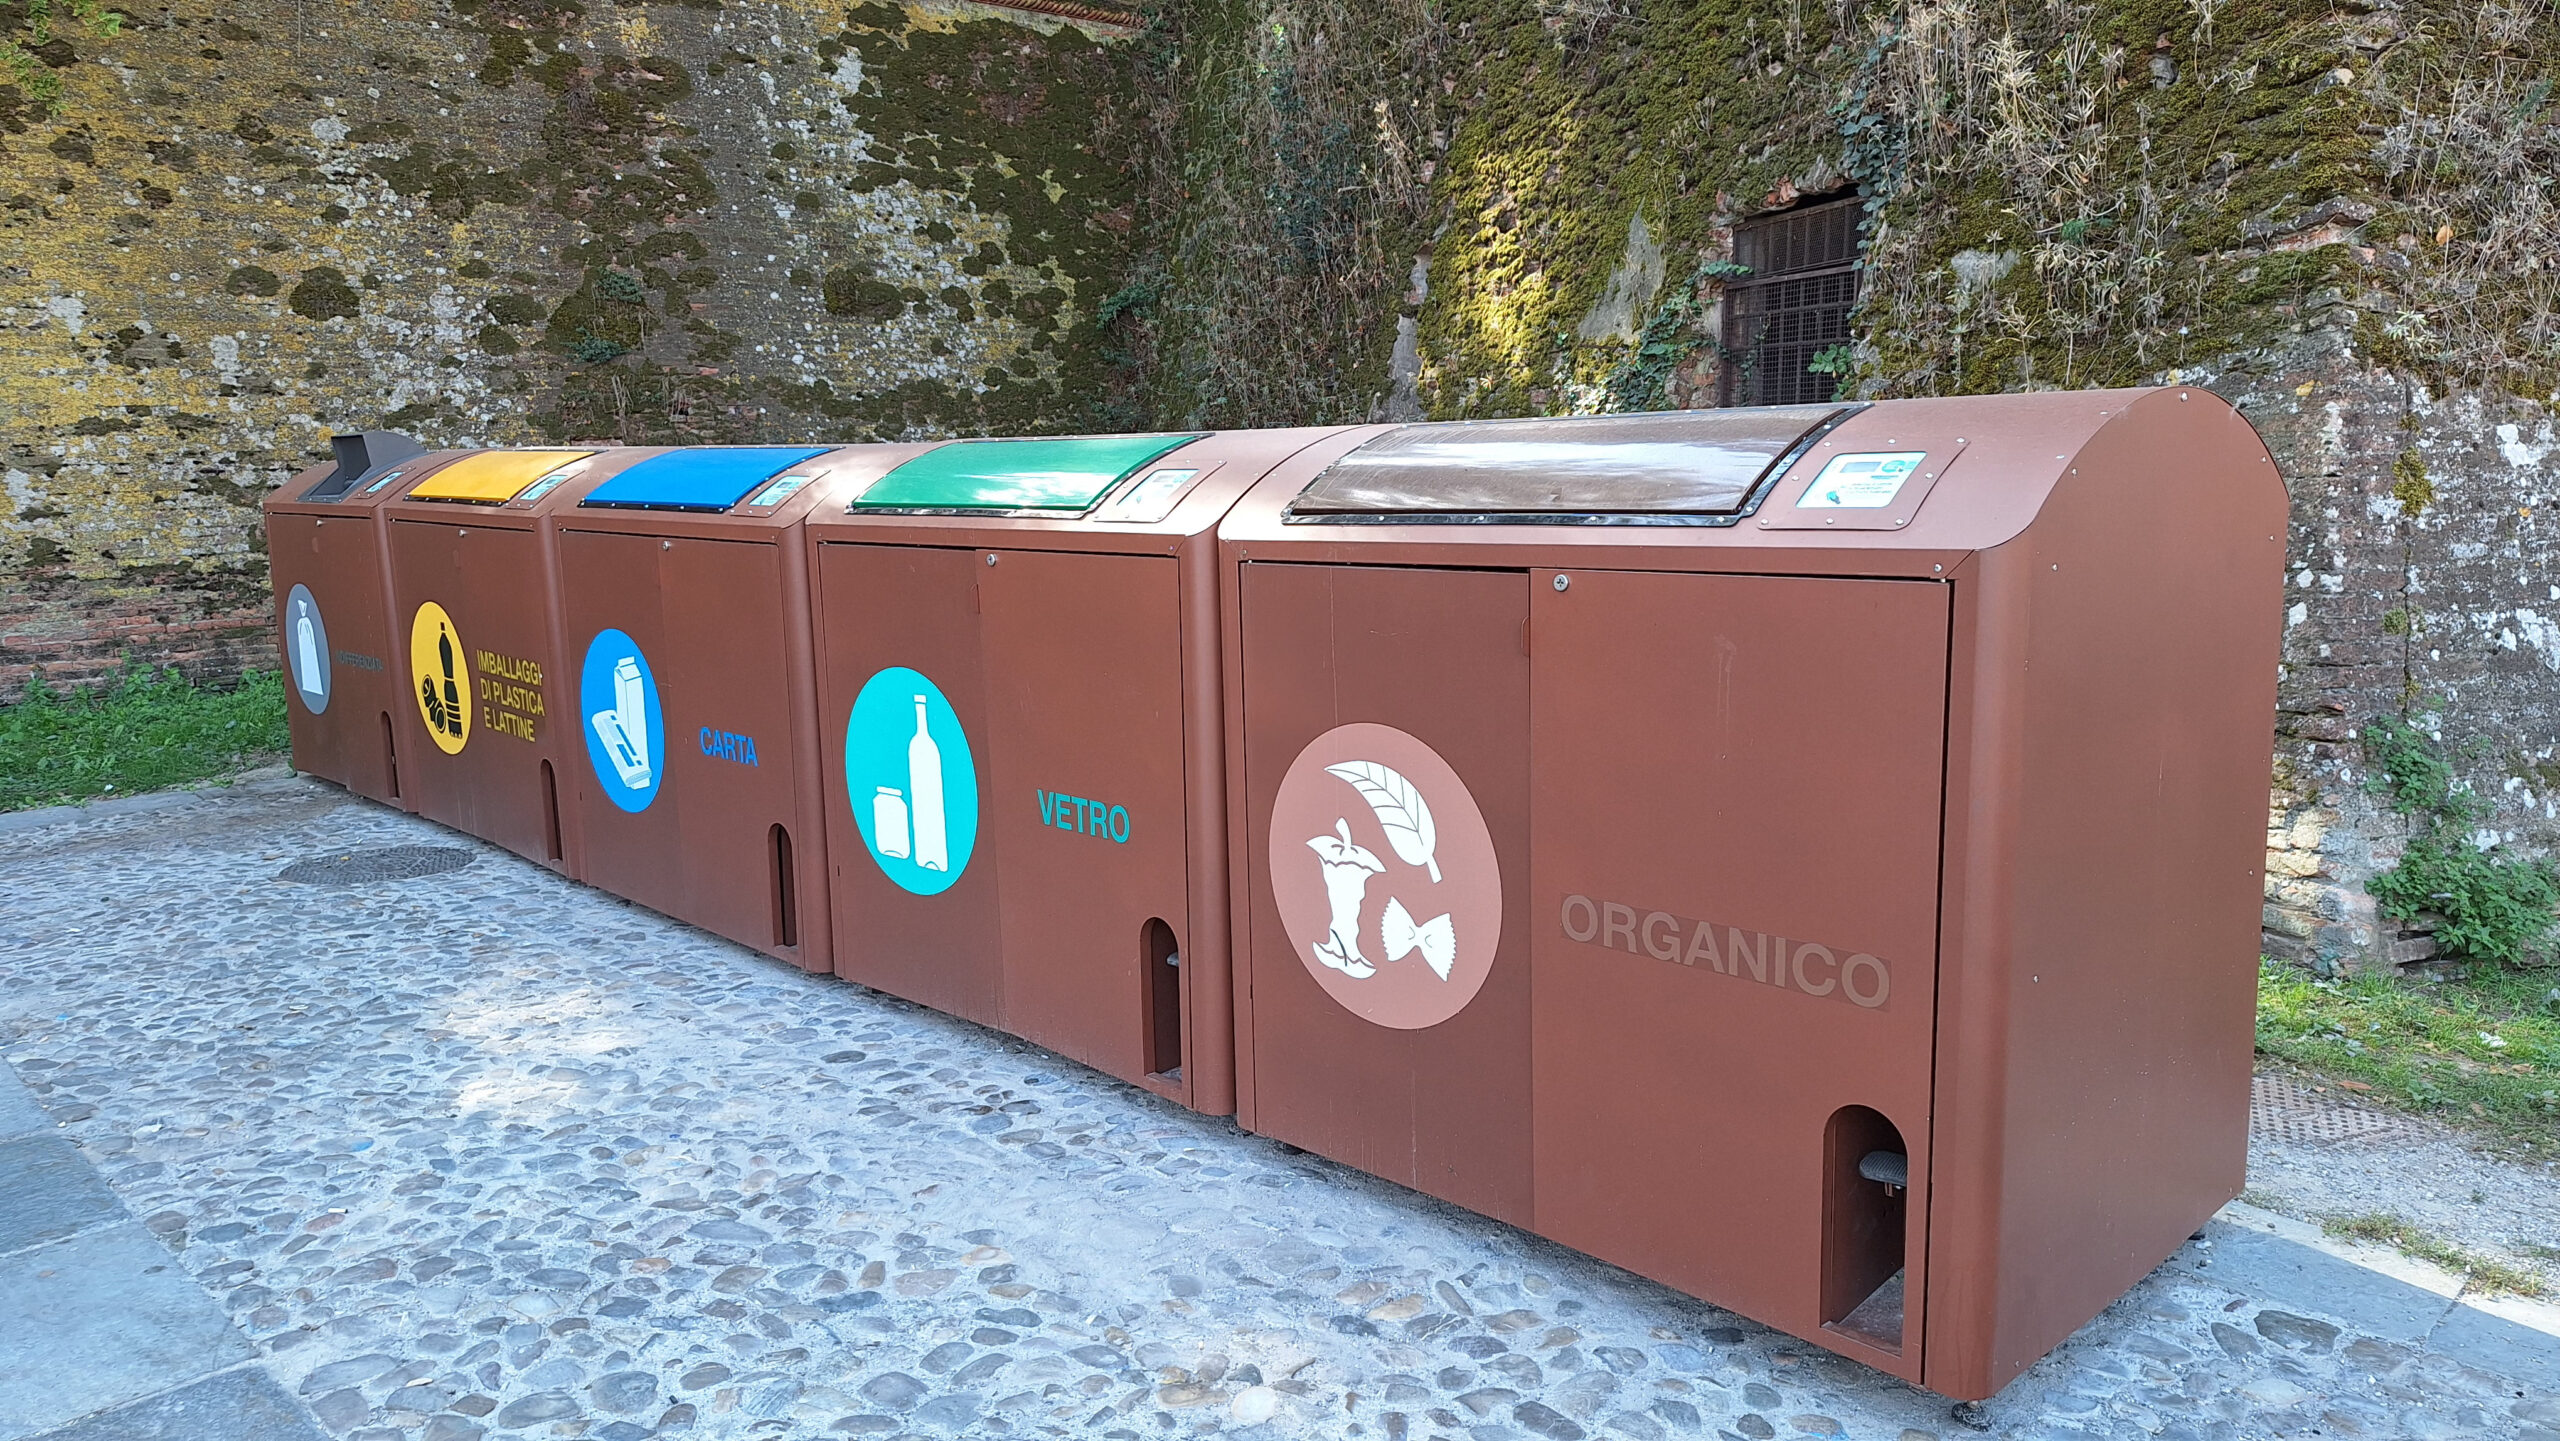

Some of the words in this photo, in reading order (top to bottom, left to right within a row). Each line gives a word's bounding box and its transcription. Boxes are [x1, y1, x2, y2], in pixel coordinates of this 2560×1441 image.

[476, 649, 542, 686] IMBALLAGGI
[480, 677, 492, 701] DI
[493, 680, 545, 717] PLASTICA
[483, 706, 492, 729] E
[493, 708, 536, 742] LATTINE
[700, 726, 758, 767] CARTA
[1037, 789, 1130, 843] VETRO
[1561, 894, 1890, 1008] ORGANICO
